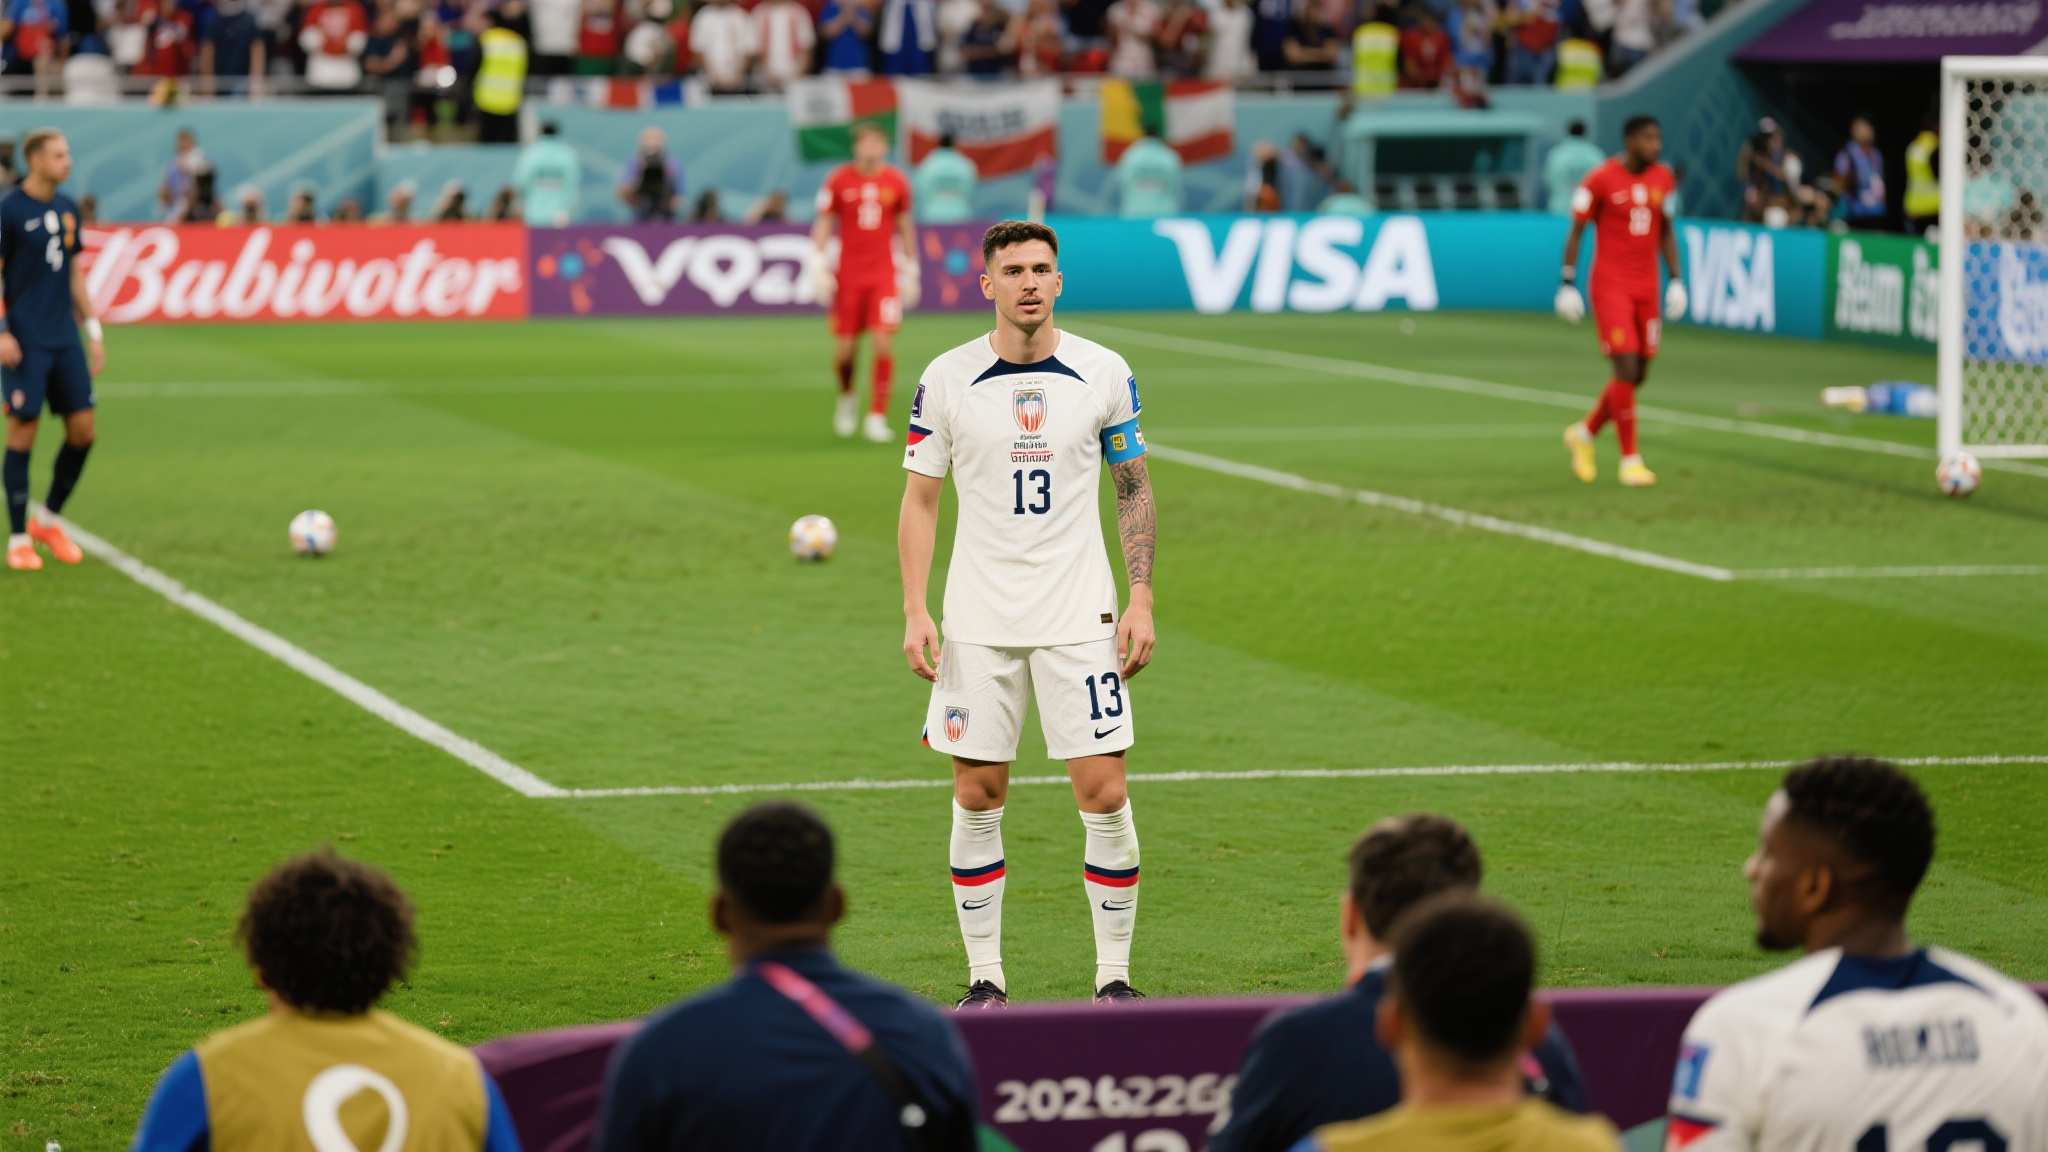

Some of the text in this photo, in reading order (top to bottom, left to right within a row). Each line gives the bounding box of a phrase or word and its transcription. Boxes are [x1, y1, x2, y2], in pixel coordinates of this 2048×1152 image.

[1152, 216, 1439, 314] VISA
[1684, 224, 1776, 332] VISA
[1012, 469, 1051, 515] 13
[1085, 671, 1124, 720] 13
